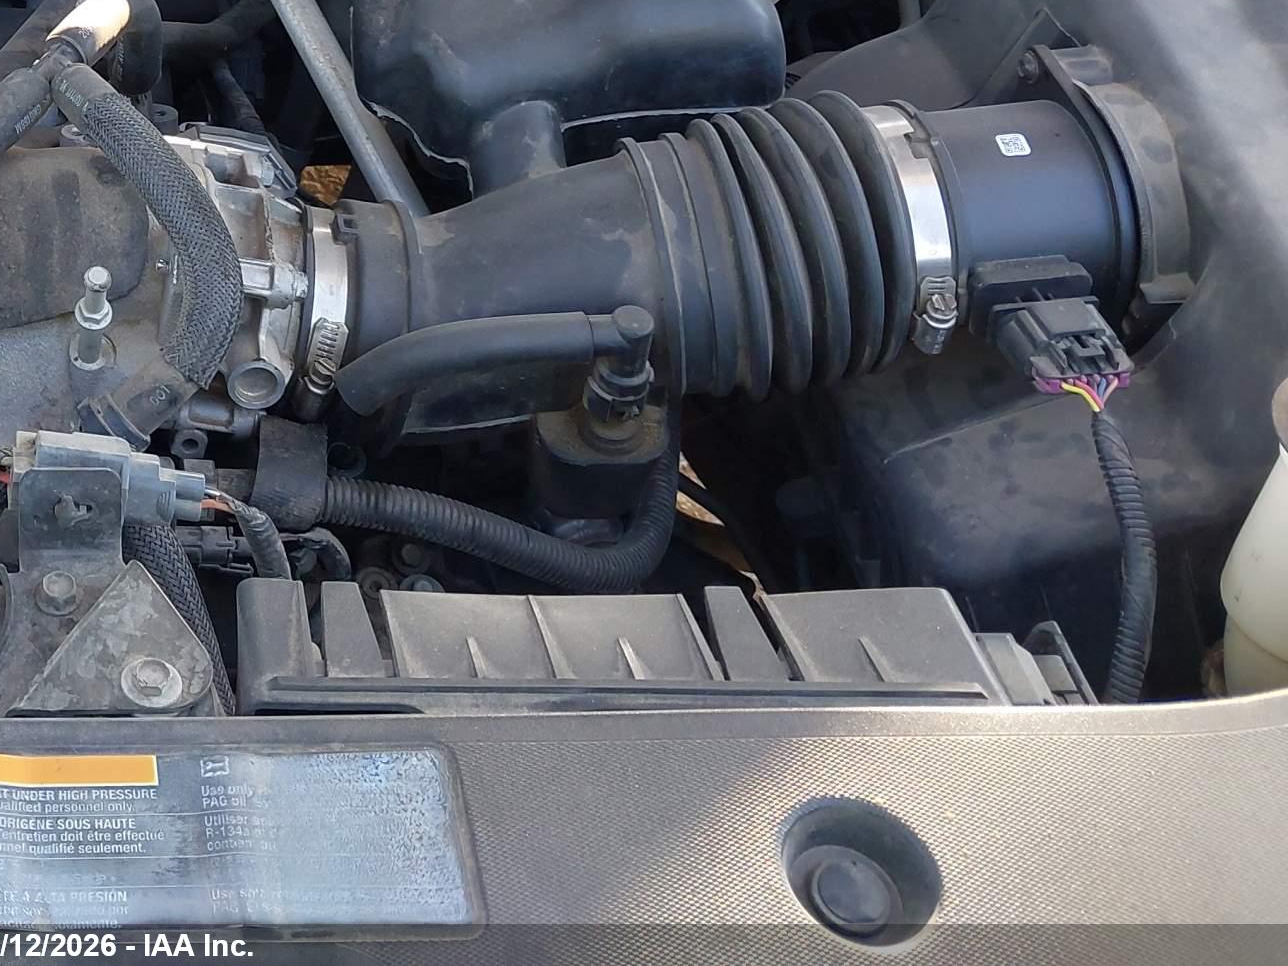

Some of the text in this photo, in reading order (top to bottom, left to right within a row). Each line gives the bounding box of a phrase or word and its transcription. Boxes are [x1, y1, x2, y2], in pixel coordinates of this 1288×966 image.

[12, 789, 55, 801] UNDER
[59, 789, 89, 801] HIGH
[92, 788, 158, 800] PRESSURE
[45, 802, 104, 814] personnel
[107, 801, 136, 813] only.
[202, 795, 228, 809] PAG
[57, 818, 91, 830] SOUS
[94, 818, 136, 829] HAUTE
[60, 830, 84, 842] doit
[87, 829, 112, 842] être
[28, 842, 75, 855] qualifié
[78, 843, 146, 854] seulement.
